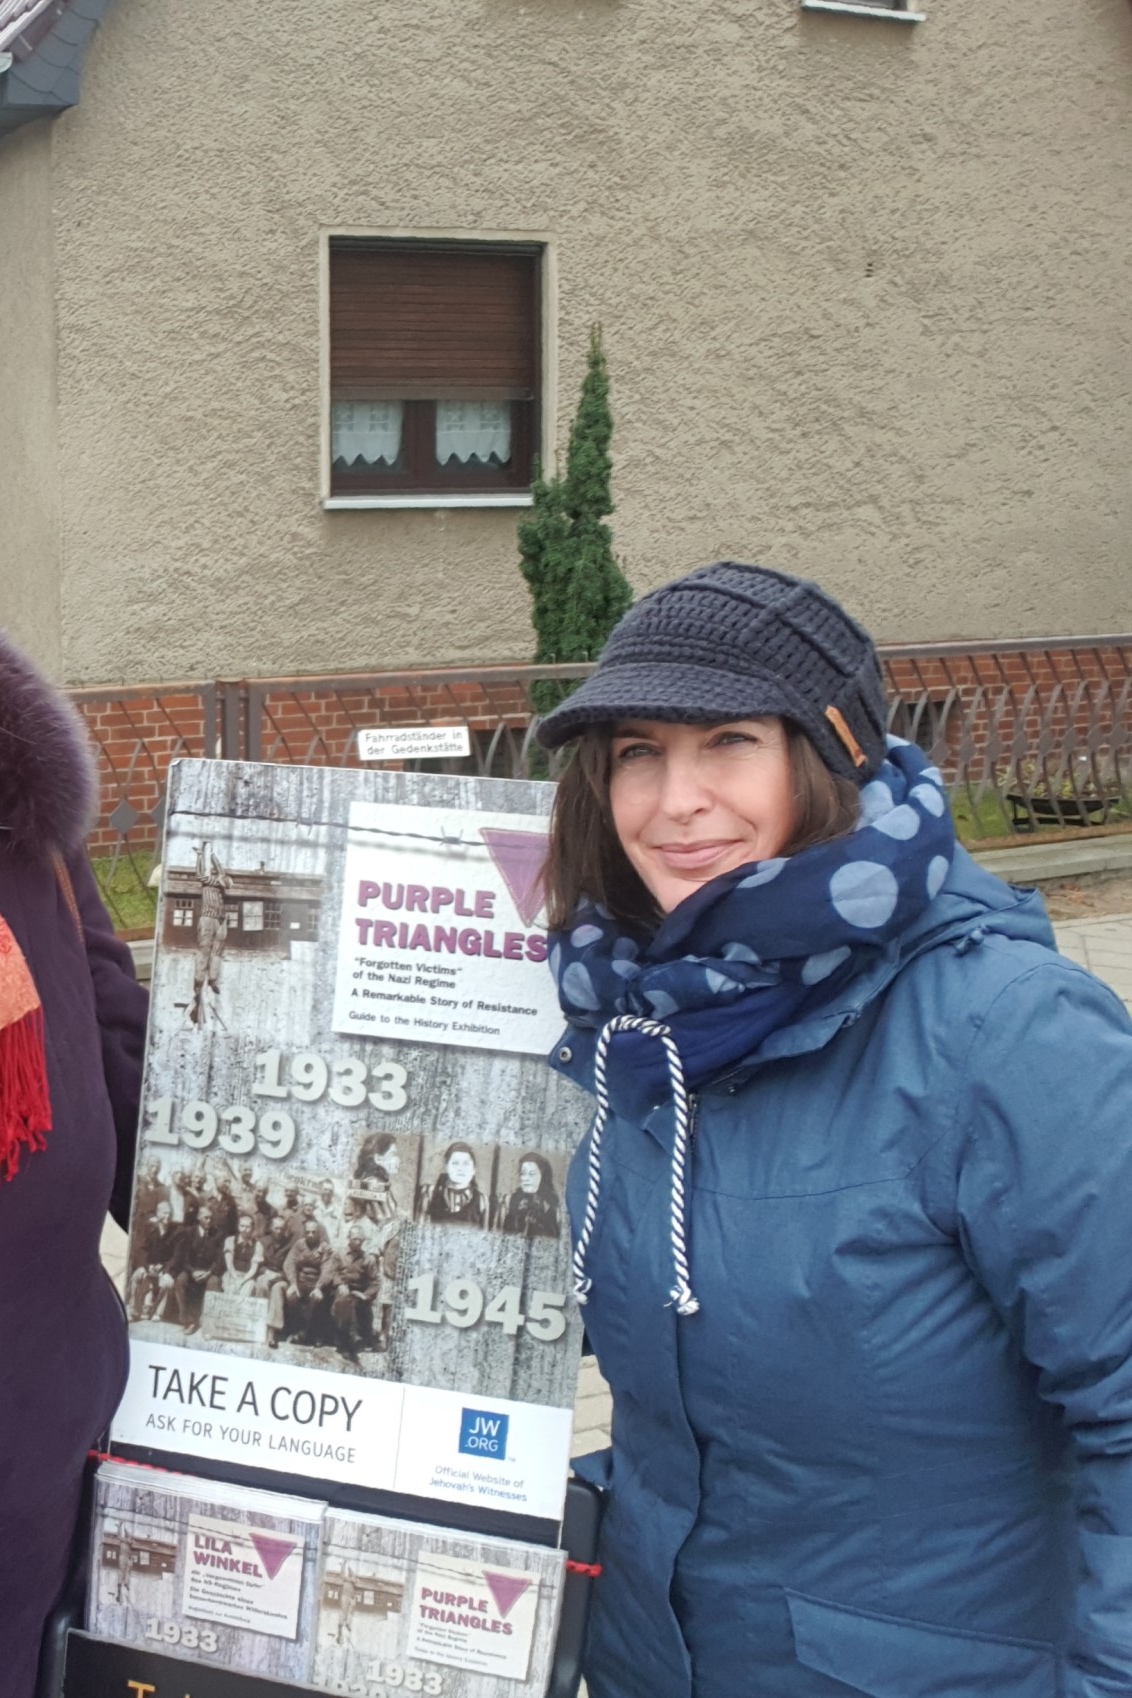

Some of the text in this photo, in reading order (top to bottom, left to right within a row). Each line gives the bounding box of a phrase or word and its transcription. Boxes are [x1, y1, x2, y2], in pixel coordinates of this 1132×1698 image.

[365, 730, 463, 743] Fahrradständer in
[367, 742, 463, 755] der Gedenkstätte
[357, 880, 496, 919] PURPLE
[355, 918, 548, 963] TRIANGLES
[352, 970, 456, 989] of the Nazi Regime
[351, 988, 538, 1016] A Remarkable Story of Resistance
[348, 1011, 500, 1035] Guide to the History Exhibition
[252, 1049, 407, 1111] 1933
[145, 1098, 295, 1159] 1939
[404, 1273, 567, 1341] 1945
[148, 1365, 363, 1432] TAKE A COPY
[145, 1413, 356, 1463] ASK FOR YOUR LANGUAGE
[469, 1416, 501, 1437] JW
[435, 1465, 525, 1489] Official Website of
[478, 1485, 528, 1502] Witnesses
[194, 1534, 233, 1556] LILA
[193, 1550, 263, 1579] WINKEL
[421, 1587, 489, 1613] PURPLE
[419, 1604, 513, 1635] TRIANGLES
[145, 1618, 218, 1653] 1933
[366, 1660, 442, 1695] 1933
